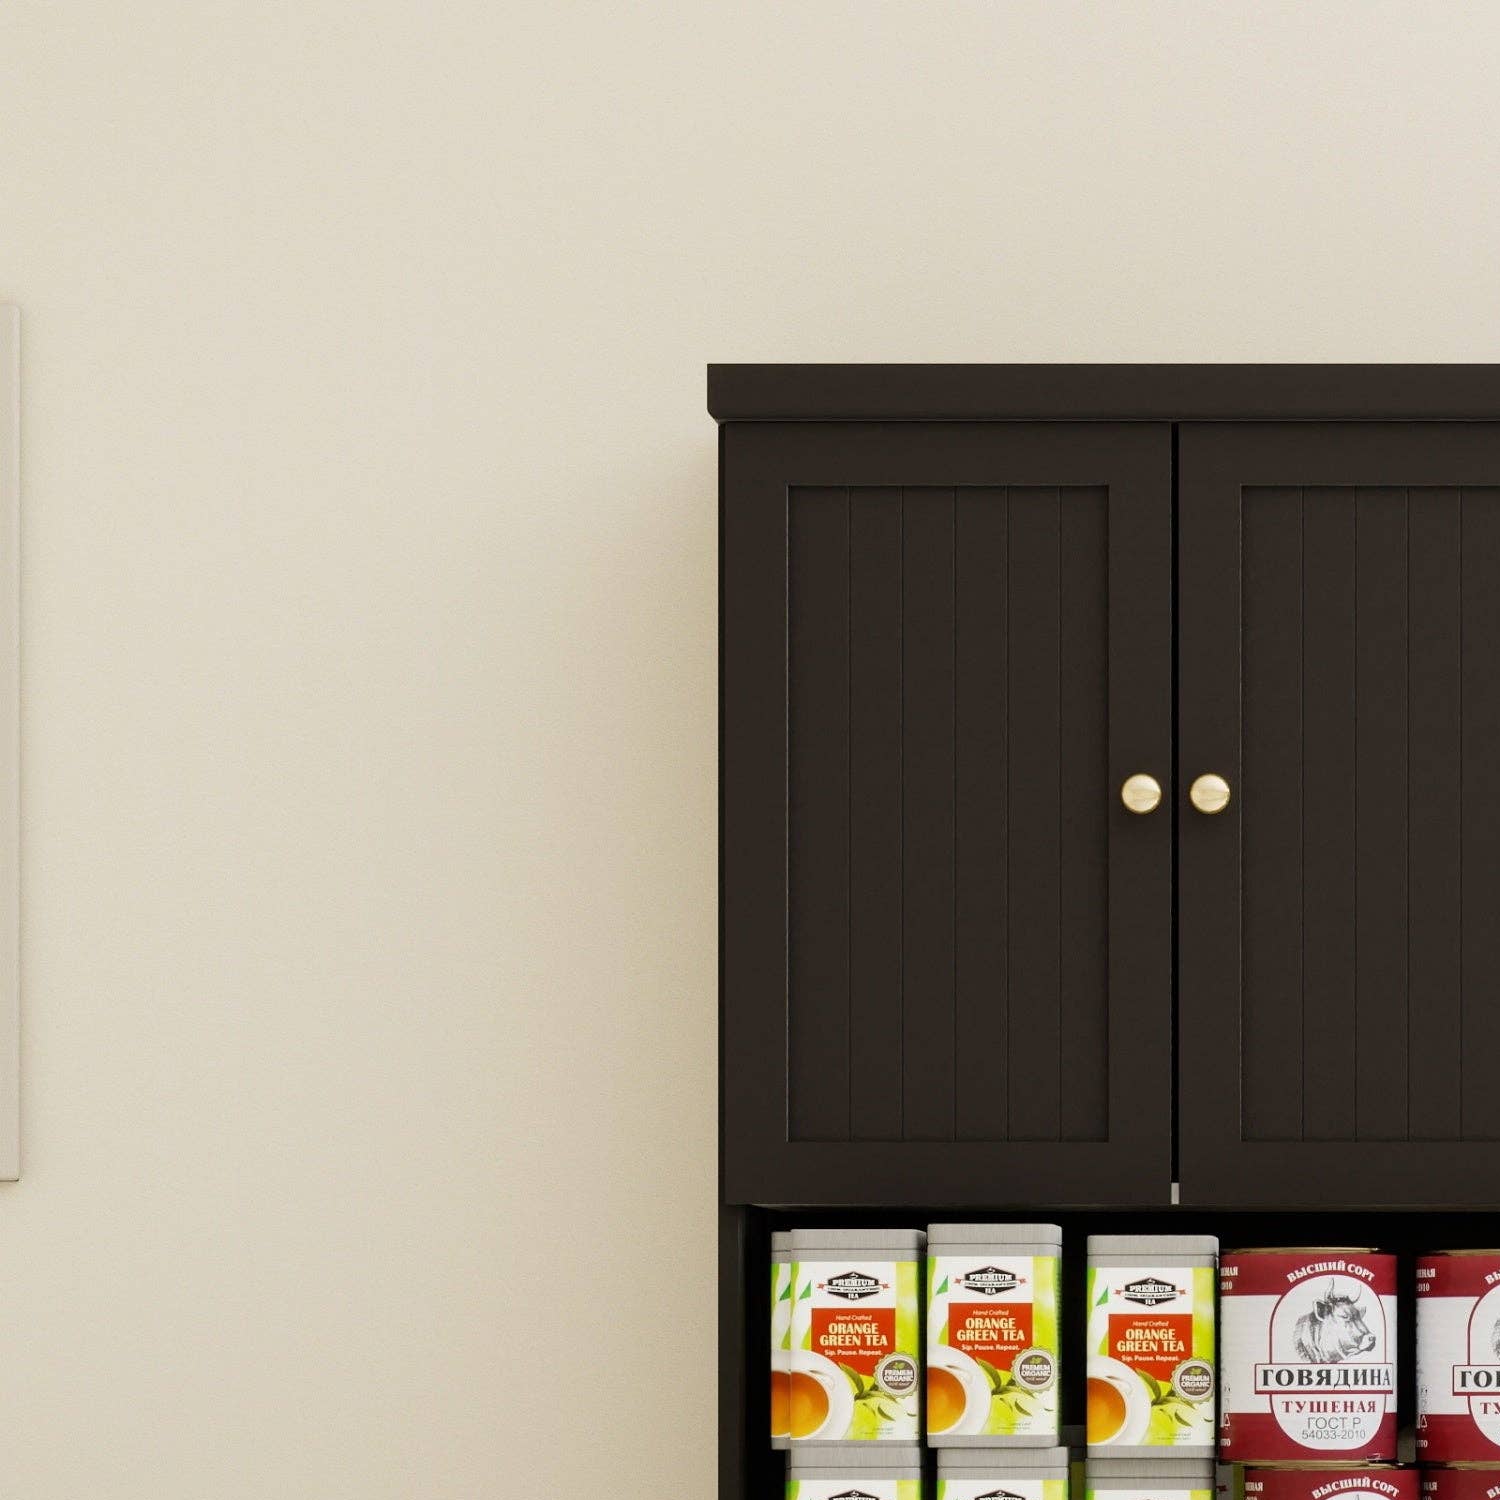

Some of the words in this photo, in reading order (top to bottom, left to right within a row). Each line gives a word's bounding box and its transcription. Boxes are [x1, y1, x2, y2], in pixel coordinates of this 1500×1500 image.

[969, 1273, 1013, 1282] PREMIUM
[1286, 1260, 1346, 1283] ВЫСШИЙ
[1348, 1263, 1376, 1282] СОРТ
[832, 1279, 876, 1287] PREMIUM
[1129, 1285, 1173, 1293] PREMIUM
[828, 1323, 879, 1335] ORANGE
[965, 1317, 1016, 1330] ORANGE
[819, 1335, 861, 1346] GREEN
[864, 1335, 888, 1346] TEA
[956, 1329, 998, 1341] GREEN
[1001, 1329, 1025, 1341] TEA
[1125, 1328, 1176, 1341] ORANGE
[1116, 1340, 1158, 1352] GREEN
[1161, 1340, 1185, 1352] TEA
[1021, 1363, 1051, 1371] PREMIUM
[1180, 1374, 1211, 1382] PREMIUM
[1262, 1368, 1391, 1389] ГОВЯДИНА
[1282, 1400, 1377, 1413] ТУШЕНАЯ
[1307, 1416, 1348, 1430] ГОСТ
[1353, 1417, 1362, 1430] Р
[1301, 1429, 1366, 1440] 54033-2010
[1312, 1476, 1371, 1500] ВЫСШИЙ
[1373, 1480, 1400, 1499] СОРТ
